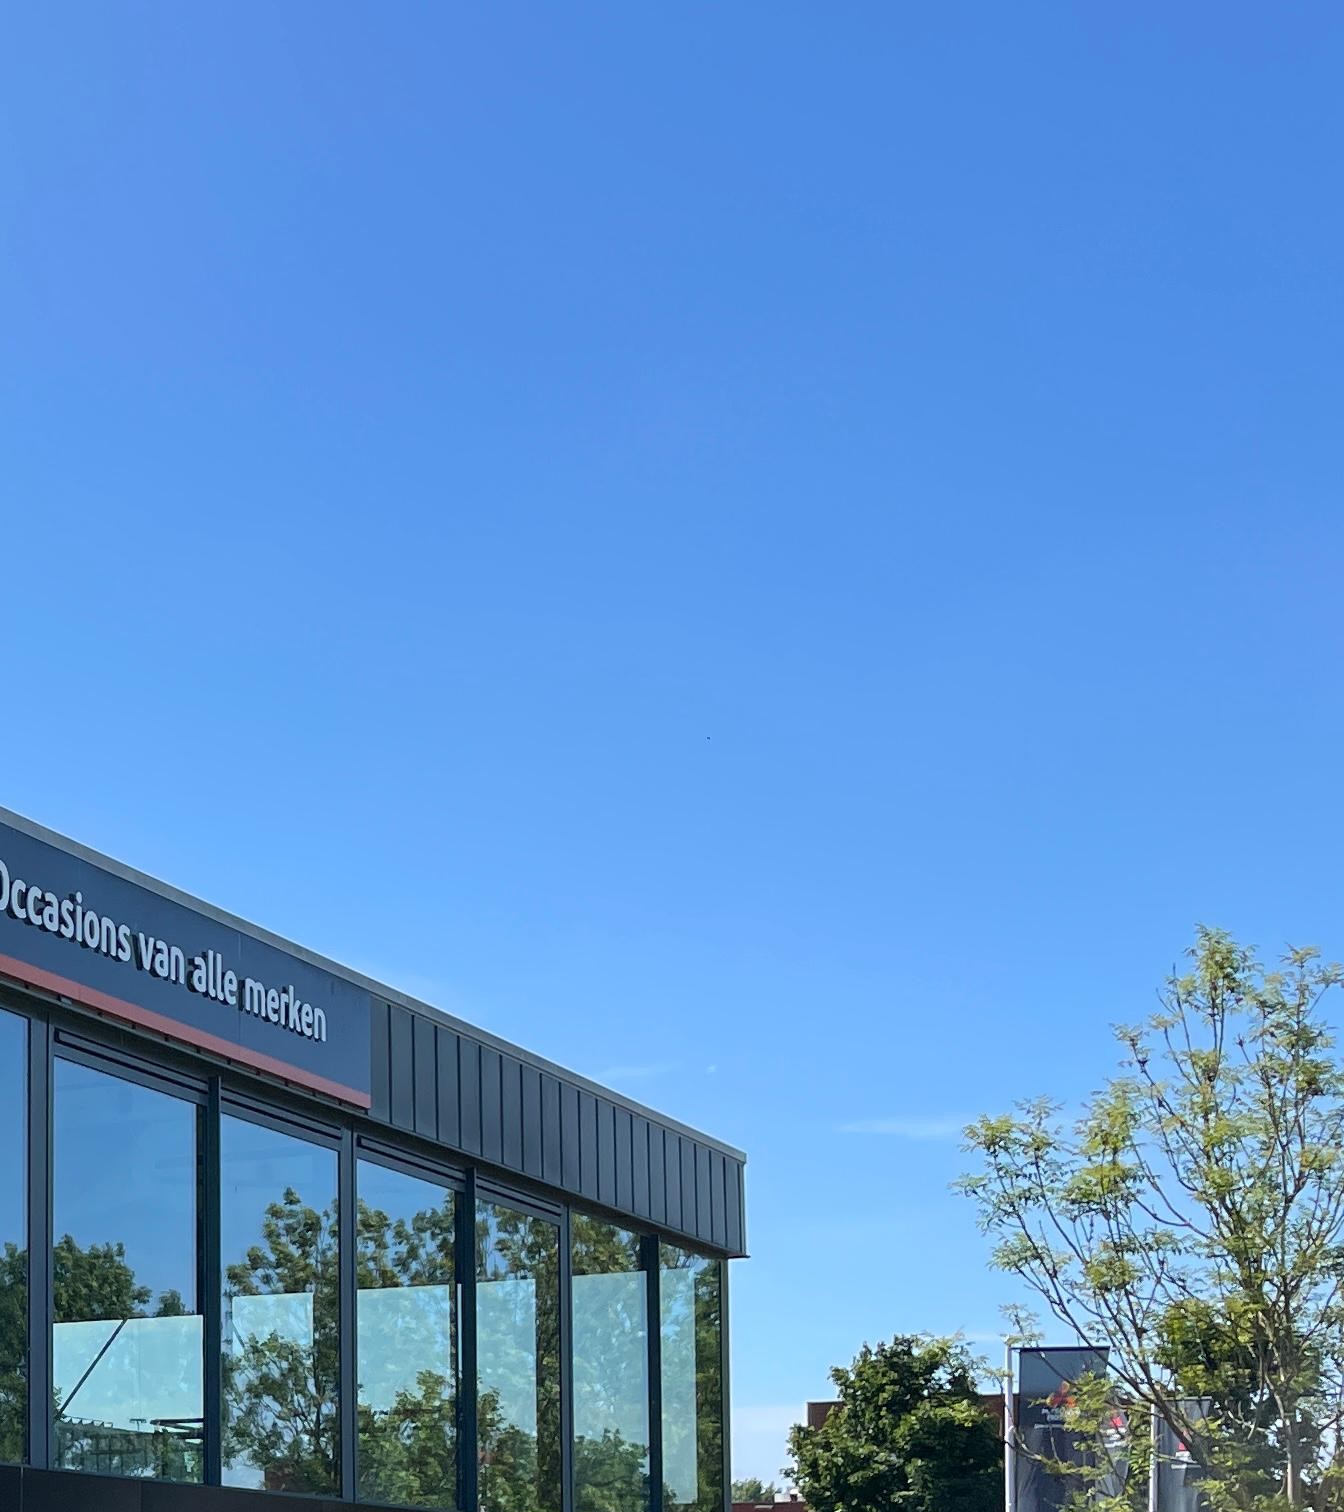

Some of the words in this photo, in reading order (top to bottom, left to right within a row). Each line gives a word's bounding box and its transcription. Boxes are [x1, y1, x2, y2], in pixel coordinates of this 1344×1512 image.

[138, 932, 185, 985] van
[193, 949, 238, 1006] alle
[243, 976, 327, 1042] merken
